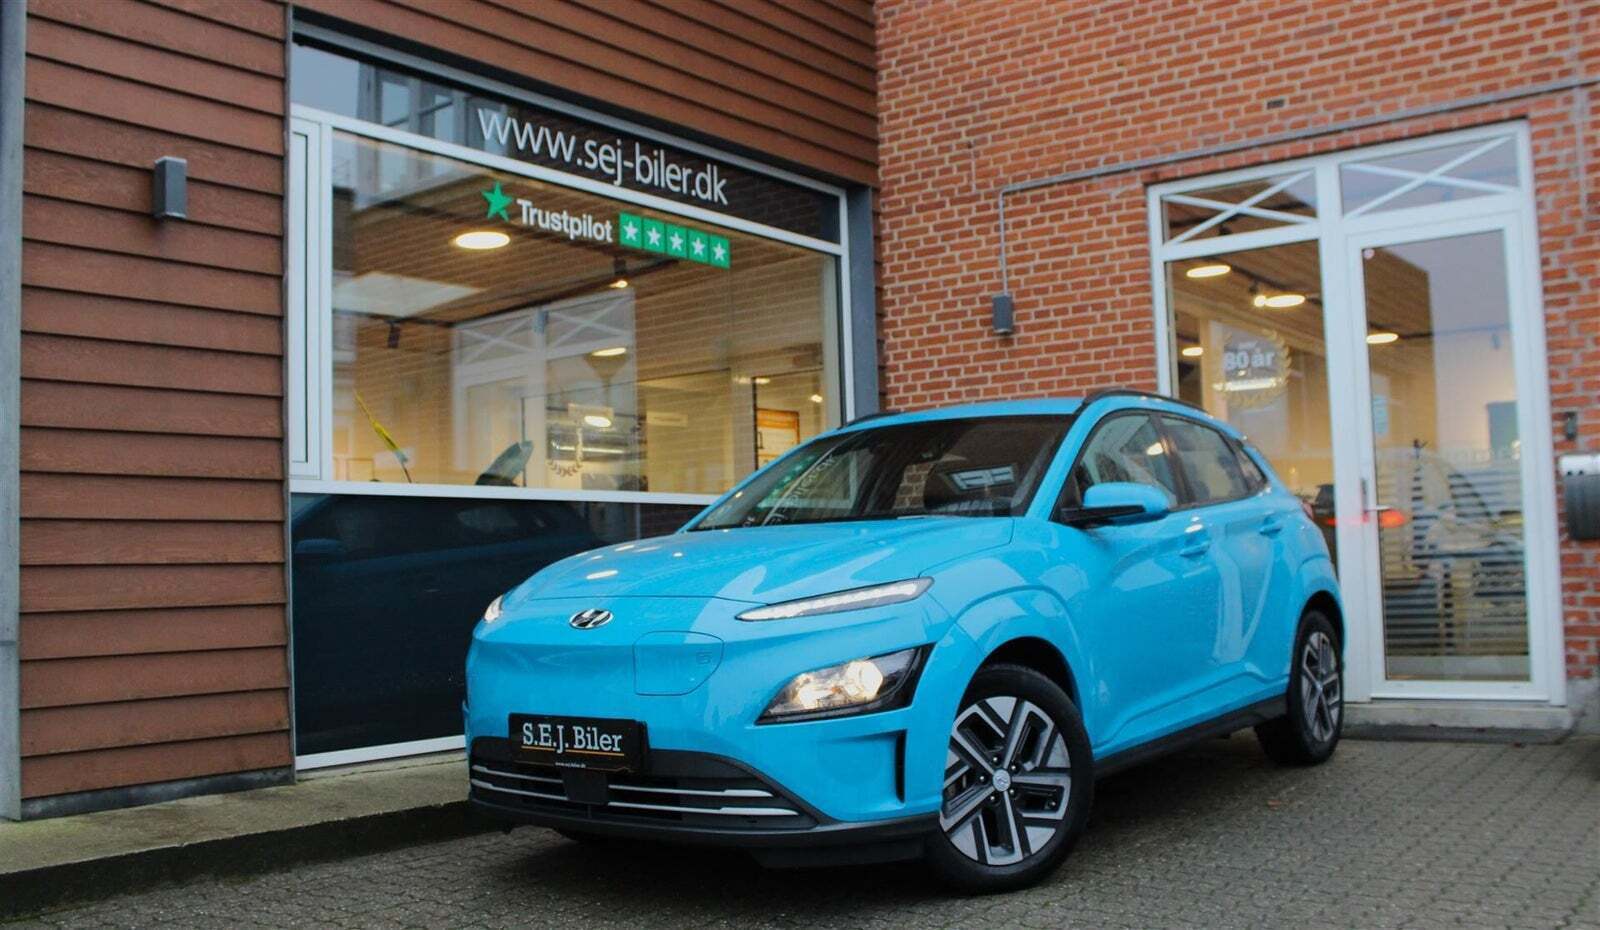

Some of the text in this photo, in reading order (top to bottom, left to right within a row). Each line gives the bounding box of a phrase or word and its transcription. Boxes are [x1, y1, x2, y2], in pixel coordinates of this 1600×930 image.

[478, 108, 728, 206] www.sej-biler.dk
[517, 198, 613, 243] Trustpilot
[522, 722, 622, 754] S.E.J. Biler
